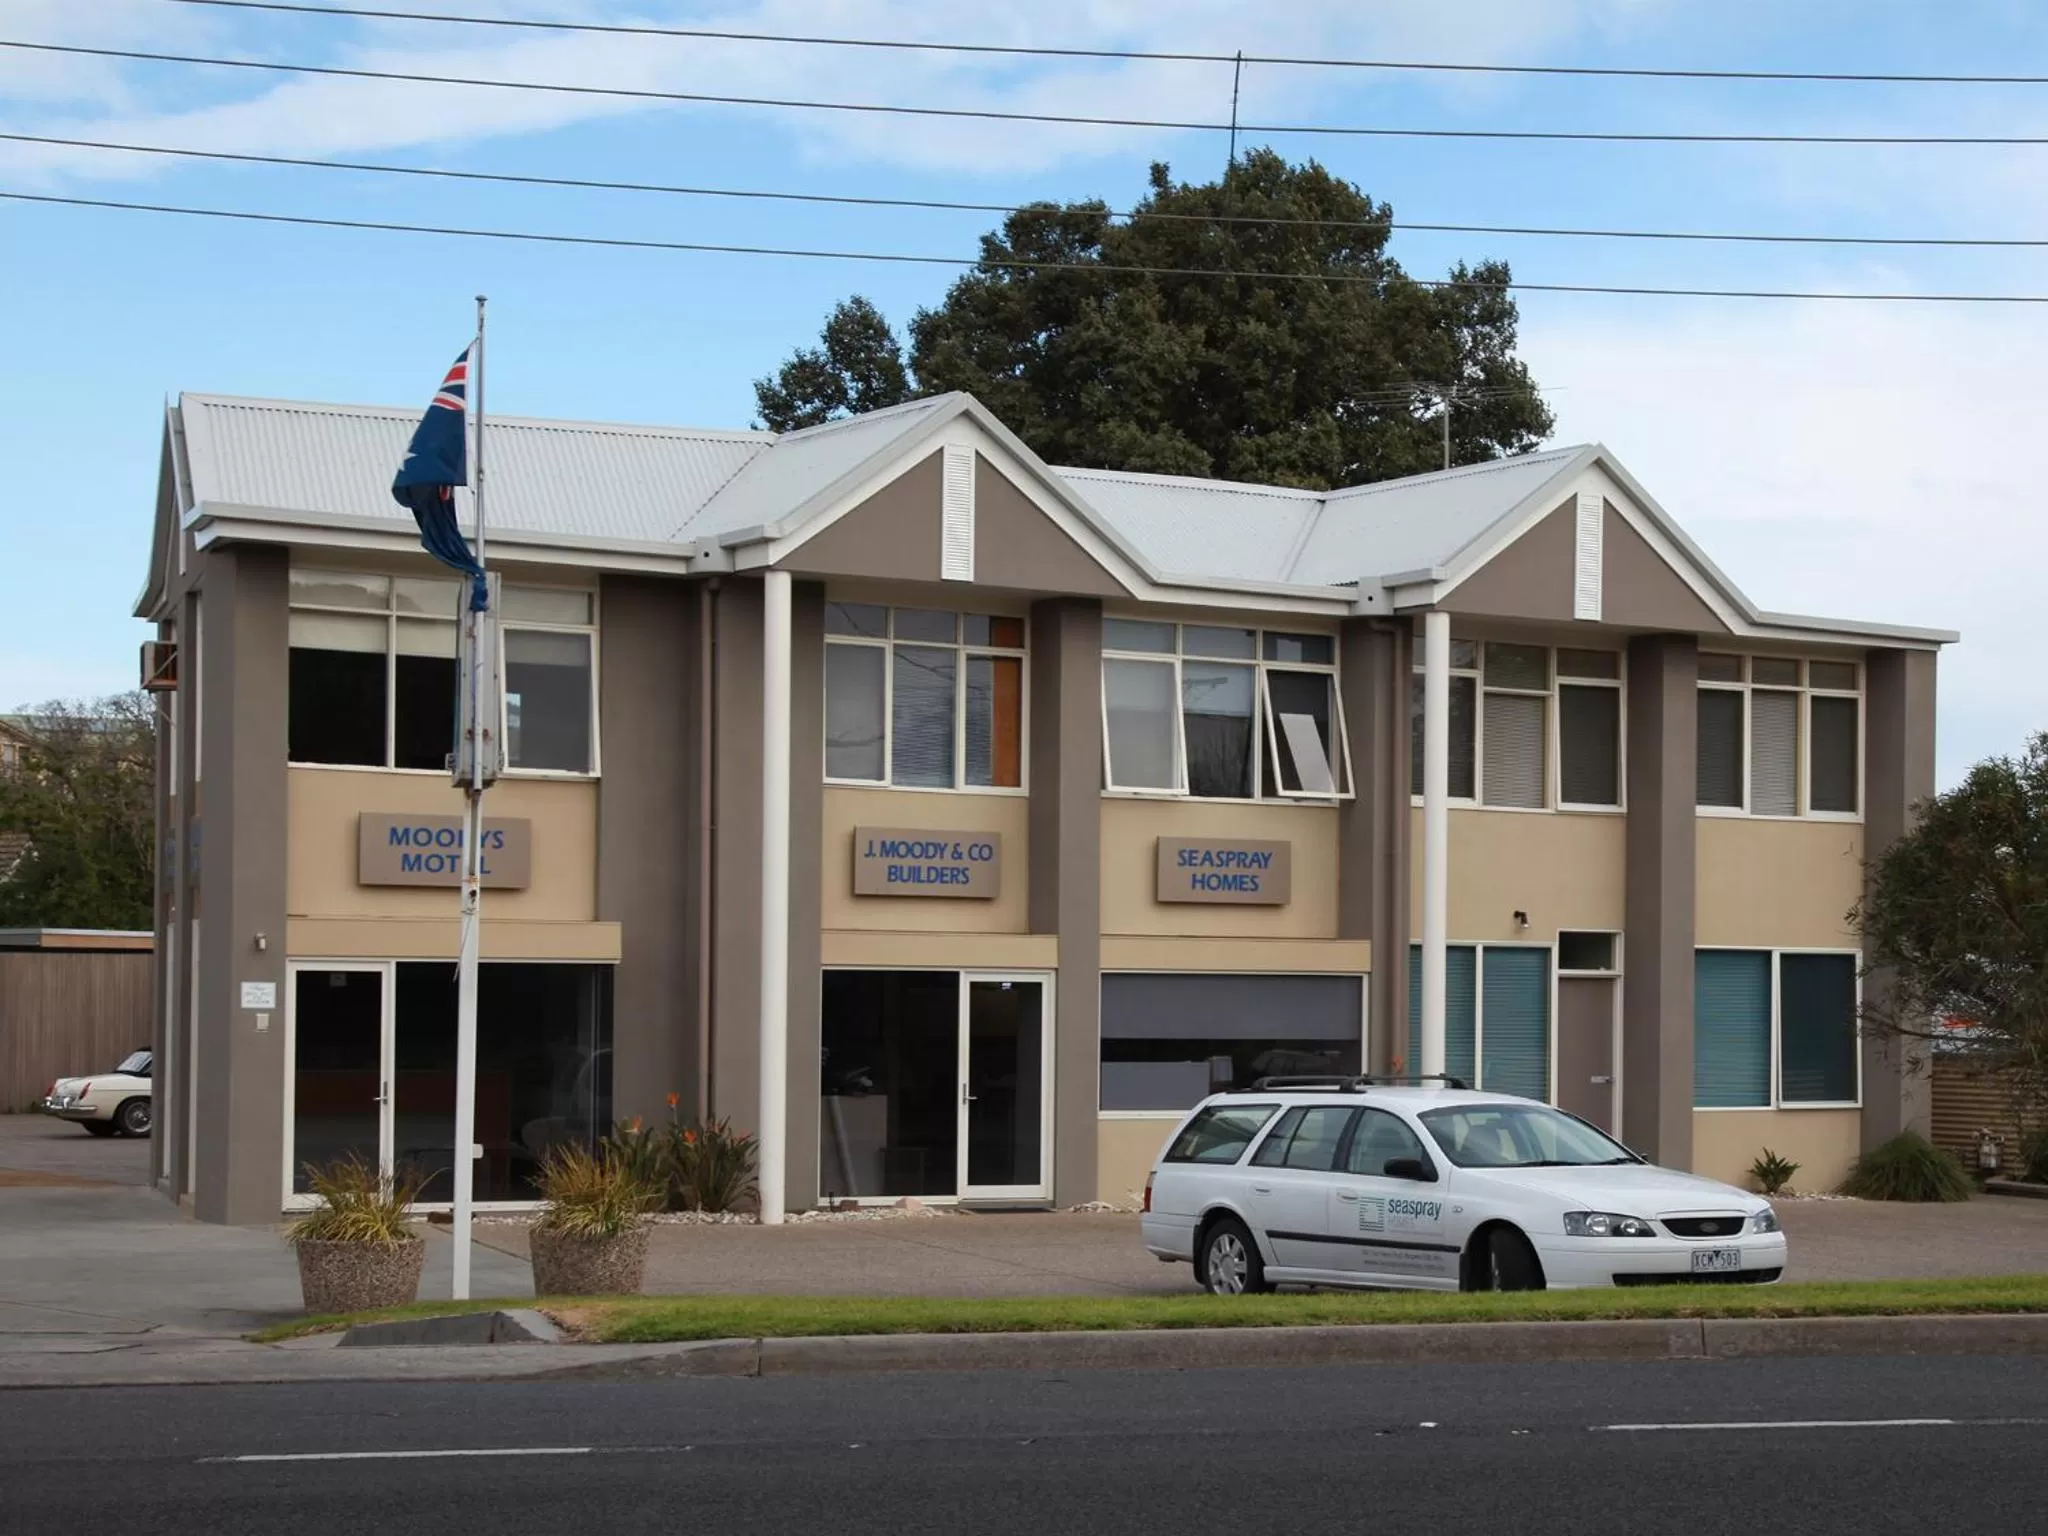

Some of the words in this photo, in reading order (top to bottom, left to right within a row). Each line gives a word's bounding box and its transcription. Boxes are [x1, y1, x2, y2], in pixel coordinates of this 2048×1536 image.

[388, 826, 505, 850] MOOYS
[863, 839, 877, 859] J.
[879, 839, 949, 861] MOODY
[951, 842, 963, 861] &
[967, 843, 994, 862] CO
[1176, 848, 1274, 870] SEASPRAY
[400, 852, 493, 876] MOTL
[886, 864, 970, 885] BUILDERS
[1190, 873, 1260, 893] HOMES
[1387, 1199, 1443, 1221] seaspray
